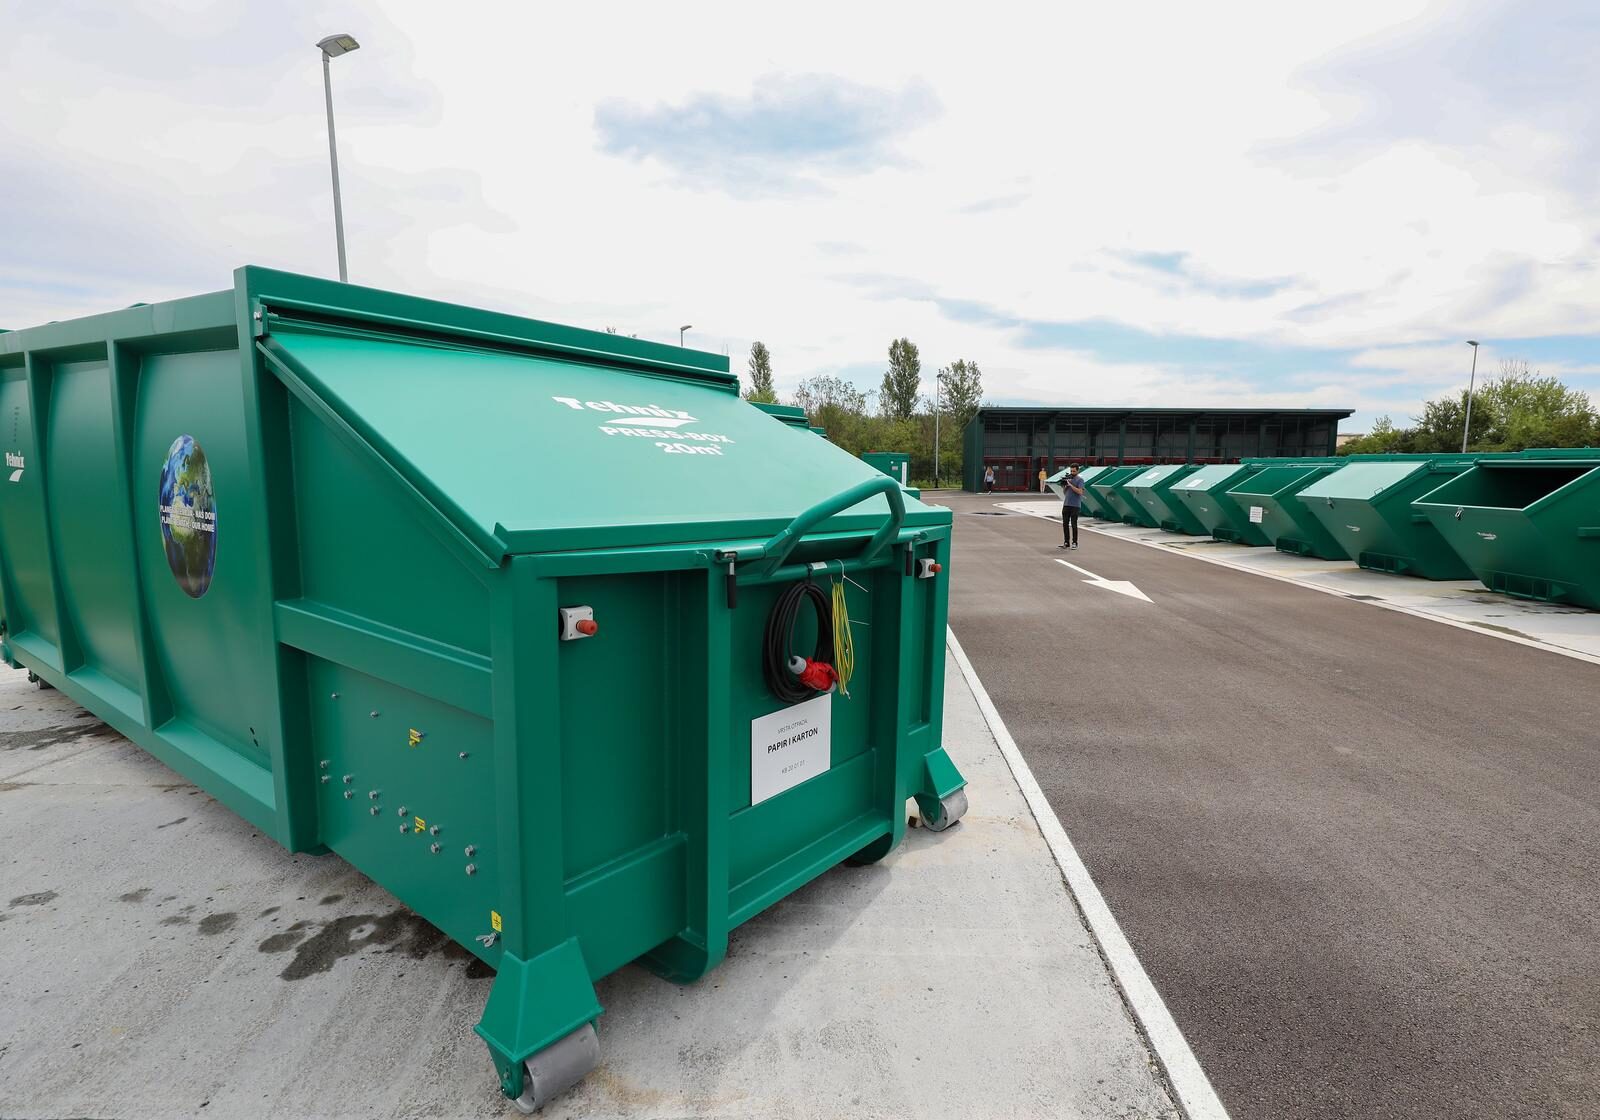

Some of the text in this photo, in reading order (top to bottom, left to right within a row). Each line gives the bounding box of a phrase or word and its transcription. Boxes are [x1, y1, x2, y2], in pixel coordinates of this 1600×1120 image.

[551, 396, 698, 420] Tehnix
[598, 426, 736, 443] PRESS-BOX
[768, 739, 787, 754] PAPIR
[792, 727, 818, 744] KARTON
